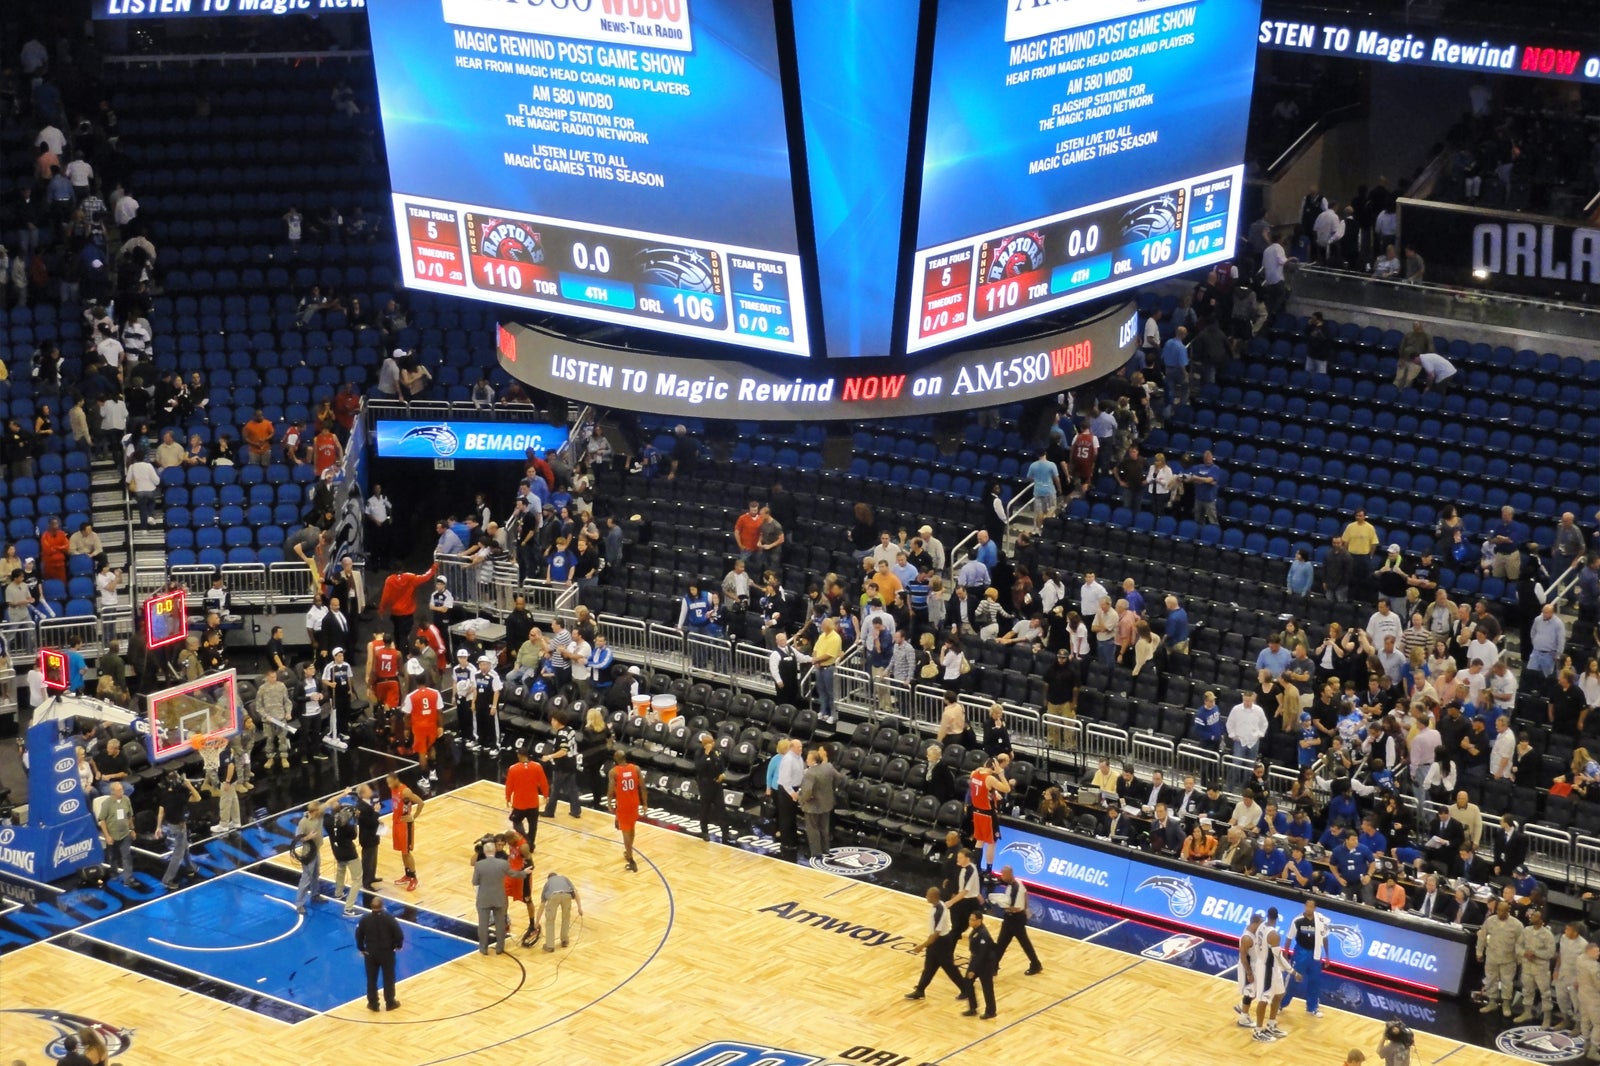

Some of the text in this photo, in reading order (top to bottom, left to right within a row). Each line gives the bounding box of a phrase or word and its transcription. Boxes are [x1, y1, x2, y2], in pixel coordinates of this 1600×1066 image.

[1009, 7, 1197, 66] MAGIC REWIND POST GAME SHOW
[454, 29, 685, 76] MAGIC REWIND POST GAME SHOW
[1005, 33, 1195, 86] HEAR FROM MAGIC HEAD COACH AND PLAYERS
[1322, 26, 1350, 52] TO
[1356, 30, 1425, 62] Magic
[1430, 38, 1516, 69] Rewind
[1520, 46, 1581, 75] NOW
[1584, 57, 1600, 78] o
[455, 56, 691, 96] HEAR FROM MAGIC HEAD COACH AND PLAYERS
[1067, 66, 1132, 95] AM 580 WDBO
[533, 85, 614, 110] AM 580 WDBO
[1052, 83, 1146, 116] FLAGSHIP STATION FOR
[519, 104, 636, 130] FLAGSHIP STATION FOR
[1039, 94, 1154, 132] THE MAGIC RADIO NETWORK
[506, 114, 650, 144] THE MAGIC RADIO NETWORK
[1055, 125, 1132, 153] LISTEN LIVE TO ALL
[532, 144, 628, 168] LISTEN LIVE TO ALL
[1028, 131, 1158, 174] MAGIC GAMES THIS SEASON
[504, 152, 664, 188] MAGIC GAMES THIS SEASON
[1194, 179, 1231, 197] TEAM FOULS
[409, 207, 456, 223] TEAM FOULS
[1204, 195, 1214, 213] 5
[427, 221, 438, 239] 5
[1192, 219, 1222, 235] TIMEOUTS
[417, 246, 456, 261] TIMEOUTS
[1068, 225, 1099, 257] 0.0
[1141, 237, 1171, 267] 106
[572, 242, 611, 274] 0.0
[929, 250, 970, 270] TEAM FOULS
[1113, 258, 1133, 275] ORL
[1472, 223, 1600, 285] ORLA
[483, 261, 523, 290] 110
[710, 250, 722, 294] BONUS
[731, 258, 784, 276] TEAM FOULS
[942, 267, 952, 286] 5
[1069, 268, 1090, 284] 4TH
[533, 279, 559, 297] TOR
[584, 286, 608, 302] 4TH
[752, 273, 764, 291] 5
[1028, 283, 1049, 300] TOR
[639, 297, 665, 314] ORL
[673, 293, 715, 323] 106
[739, 300, 783, 315] TIMEOUTS
[928, 293, 963, 310] TIMEOUTS
[986, 282, 1019, 312] 110
[551, 355, 613, 388] LISTEN
[621, 369, 649, 392] TO
[656, 374, 730, 404] Magic
[739, 378, 835, 402] Rewind
[843, 375, 906, 401] NOW
[912, 376, 943, 398] on
[1051, 340, 1093, 378] WDBO
[381, 661, 392, 672] 14
[422, 697, 430, 710] 9
[622, 778, 635, 791] 30
[57, 838, 93, 860] Amway
[757, 901, 905, 947] Amway
